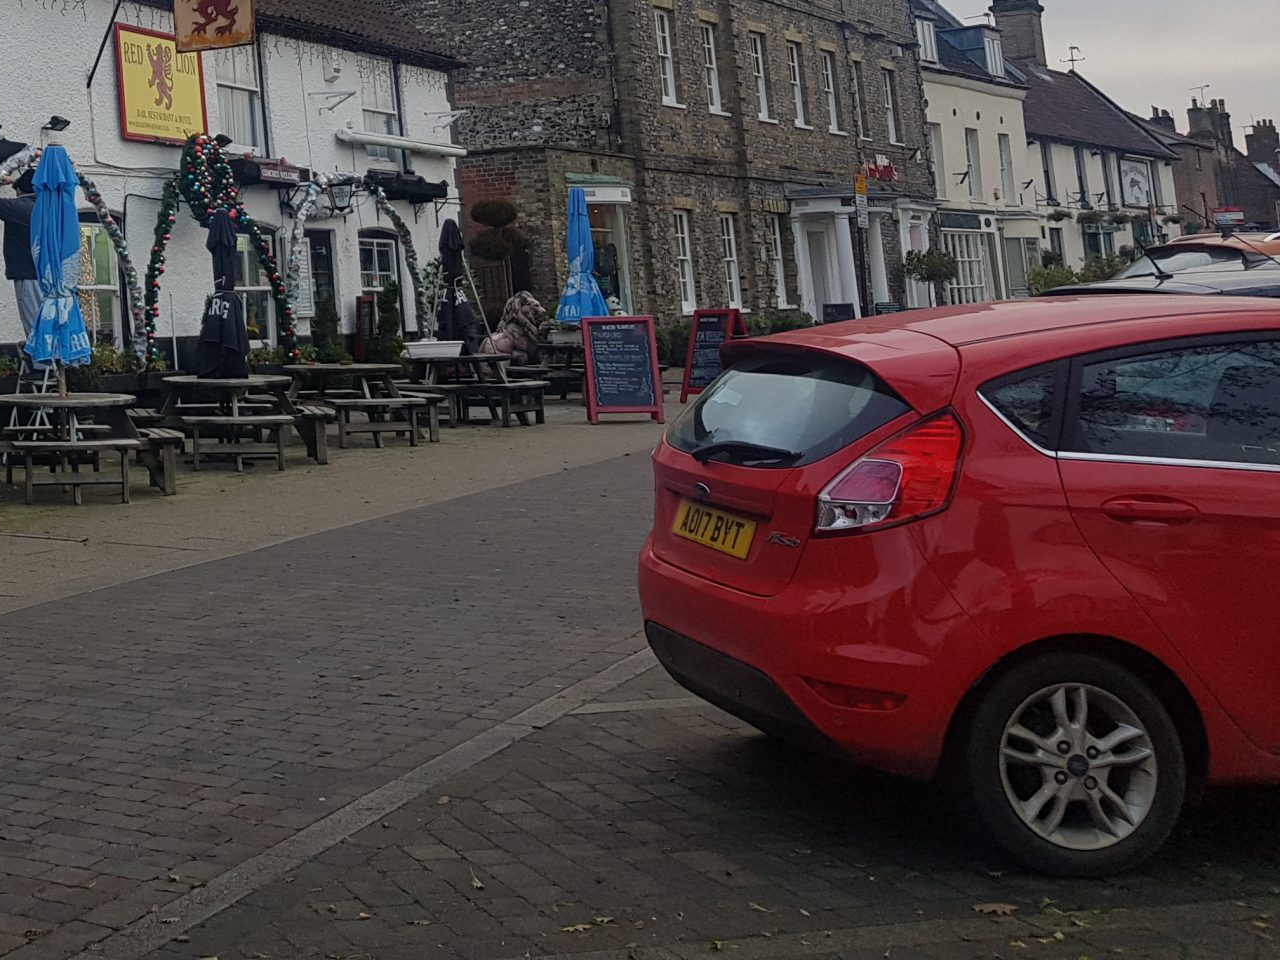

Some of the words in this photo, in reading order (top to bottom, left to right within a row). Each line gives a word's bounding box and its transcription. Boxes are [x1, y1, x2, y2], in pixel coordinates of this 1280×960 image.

[123, 41, 144, 66] RED
[175, 53, 197, 77] LION
[711, 514, 745, 550] BYT
